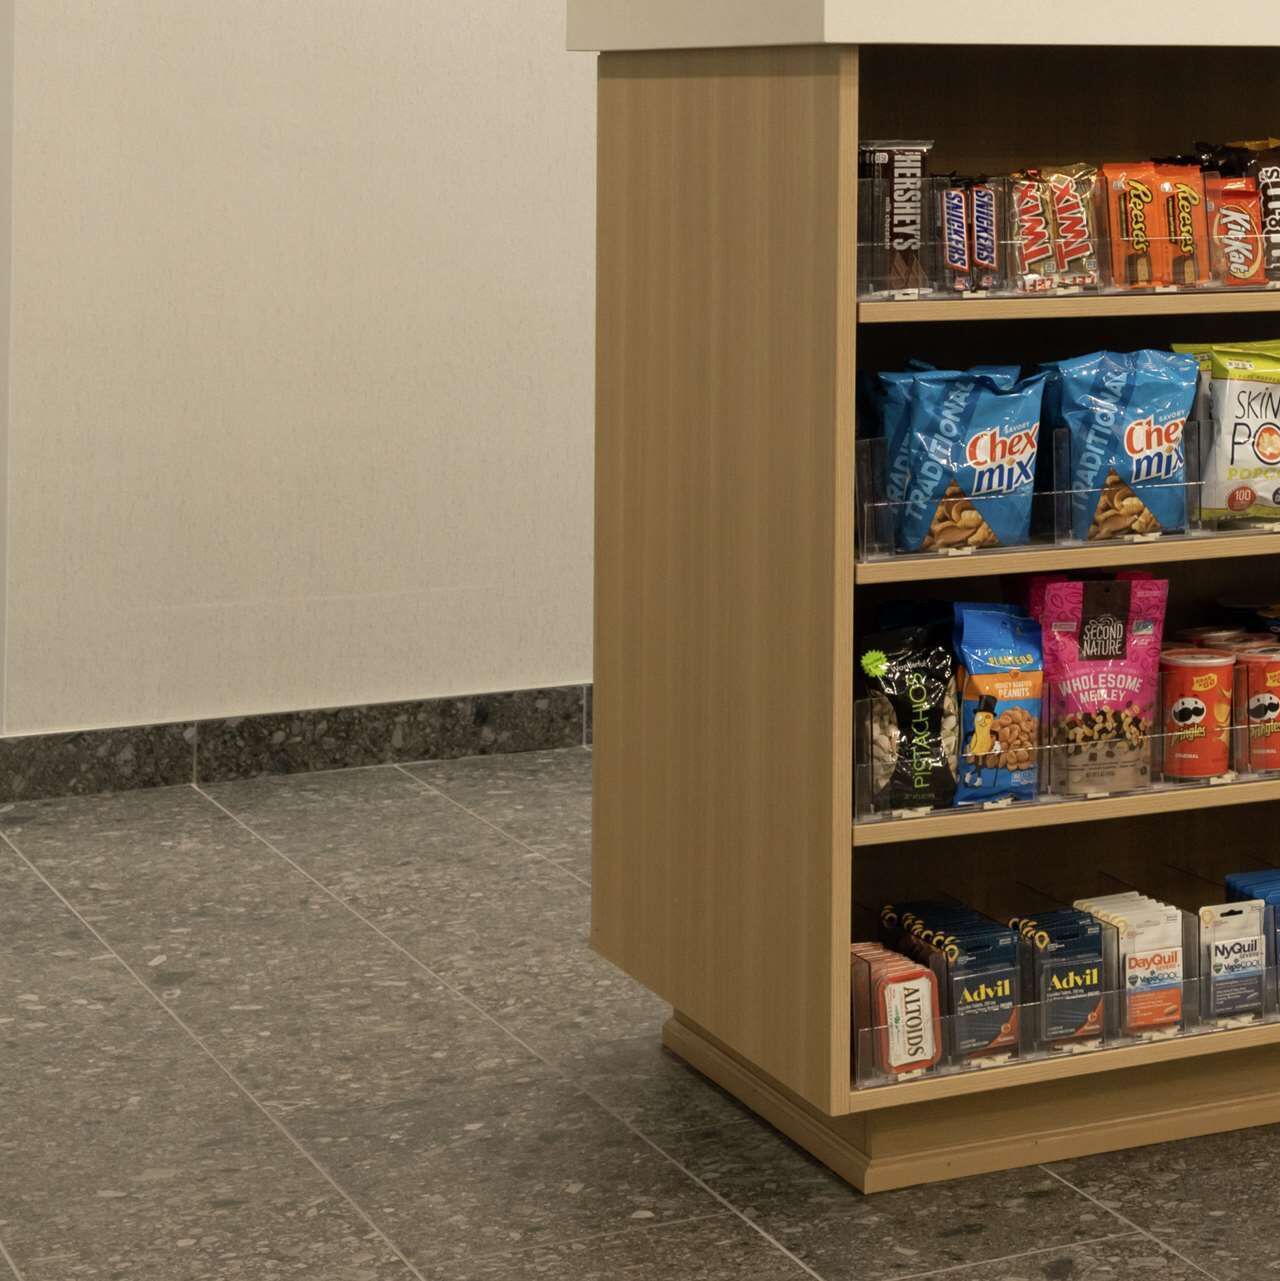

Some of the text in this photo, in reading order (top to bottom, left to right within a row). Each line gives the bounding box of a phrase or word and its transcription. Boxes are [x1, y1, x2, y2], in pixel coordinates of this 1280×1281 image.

[893, 154, 922, 251] HERSHEY'S
[945, 191, 968, 270] SNICKERS
[975, 190, 995, 266] SNICKERS
[1013, 181, 1053, 274] TWIX
[1051, 176, 1095, 272] TWIX
[905, 380, 975, 520] TRADITIONAL
[967, 423, 1040, 468] Chex
[973, 452, 1036, 494] mix
[1234, 489, 1252, 502] 100
[1081, 639, 1122, 657] NATURE
[1082, 622, 1124, 641] SECOND
[1058, 673, 1144, 697] WHOLESOME
[1079, 688, 1127, 704] MEDLEY
[906, 672, 933, 789] PISTACHIOS
[1128, 951, 1178, 970] DayQuil
[1214, 939, 1258, 960] NyQuil
[959, 978, 1010, 1004] Advil
[1048, 967, 1099, 992] Advil
[902, 986, 925, 1057] ALTOIDS
